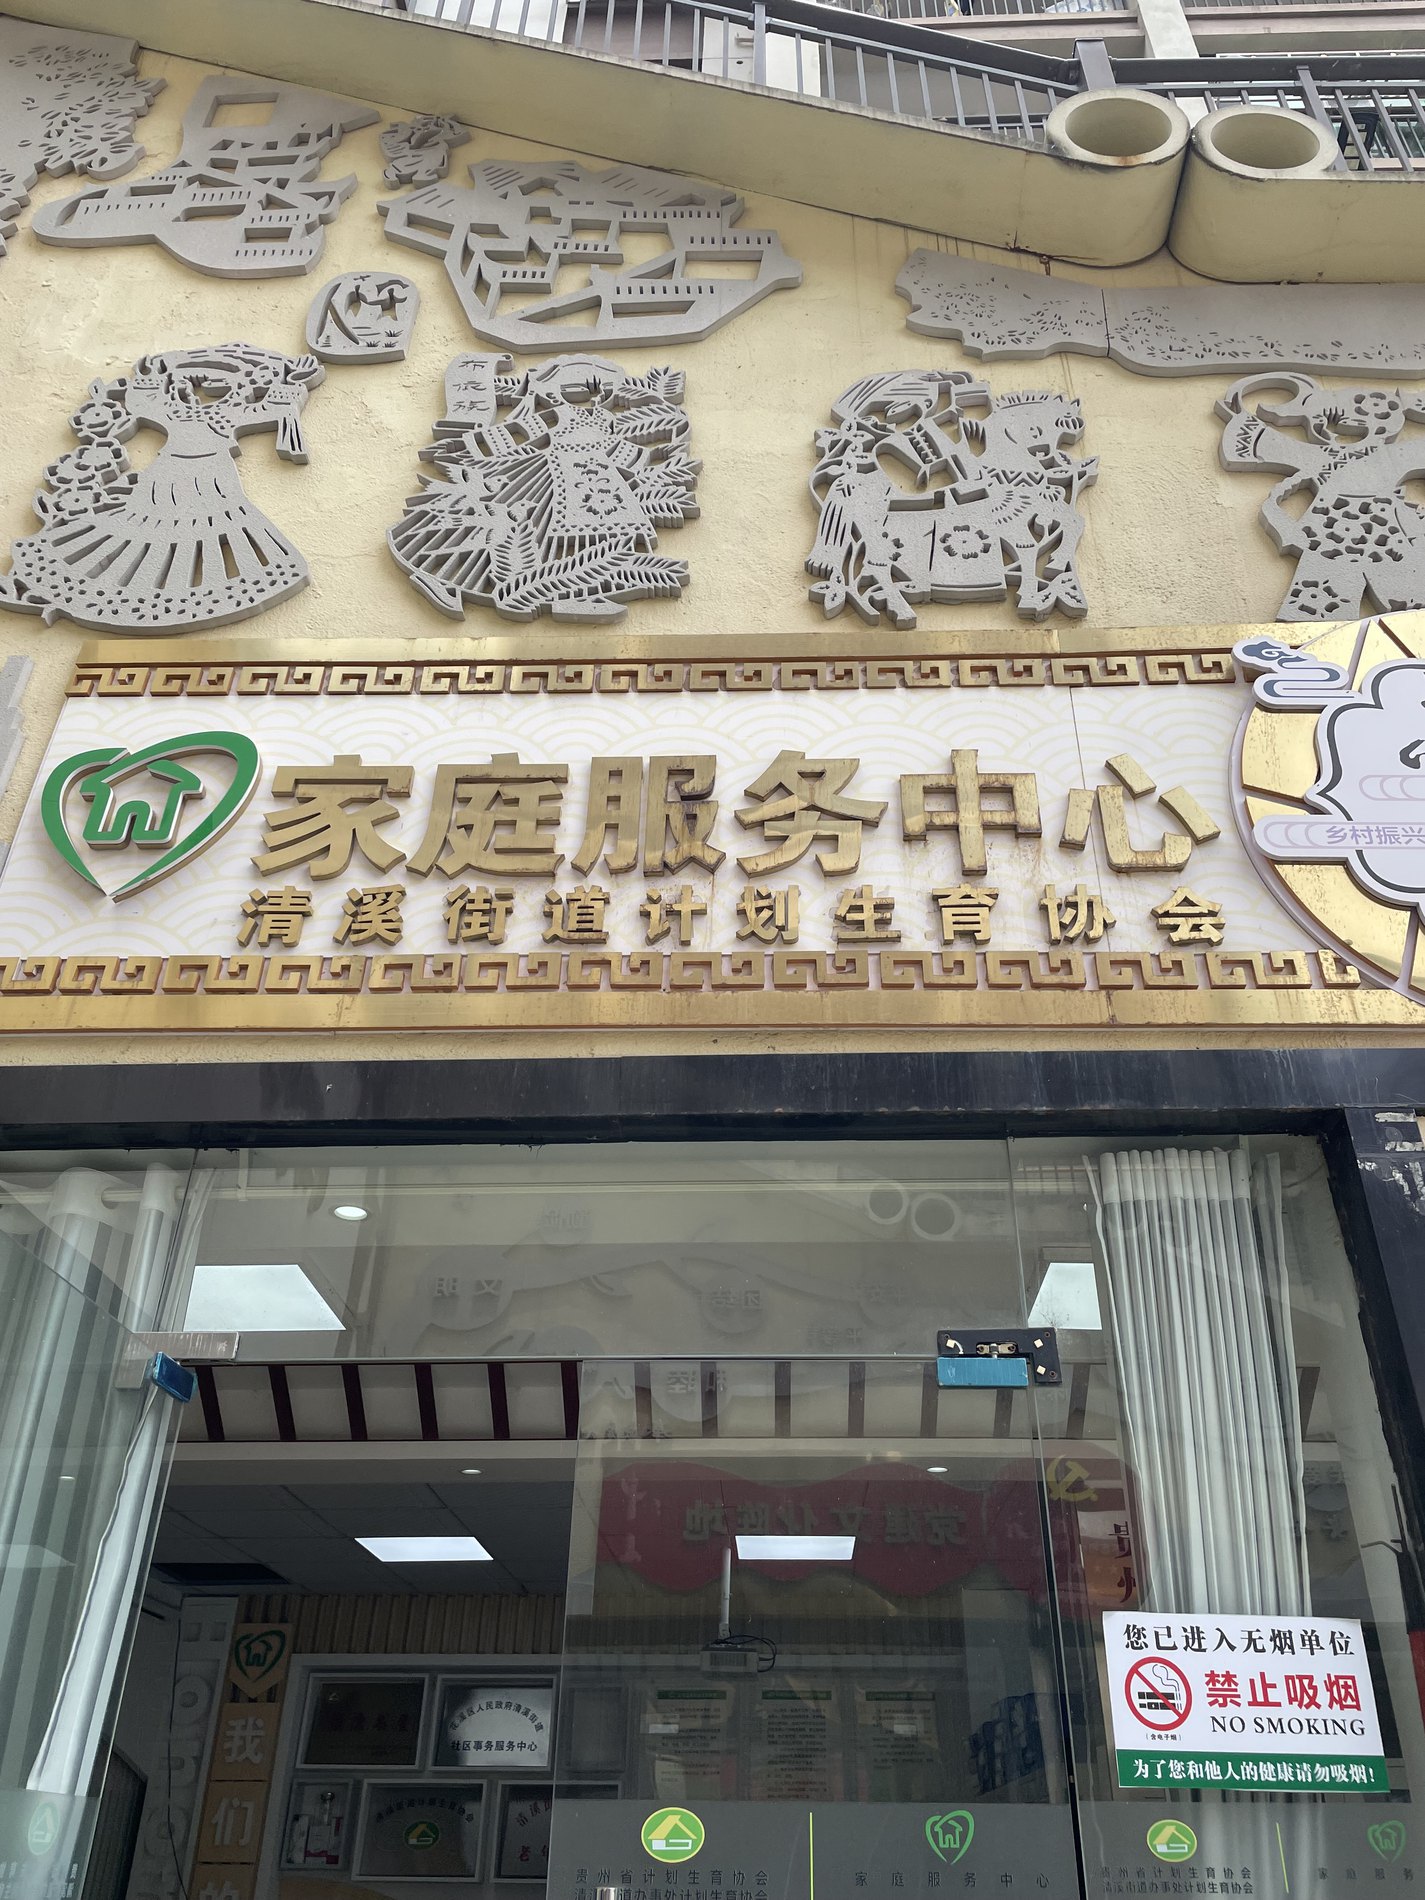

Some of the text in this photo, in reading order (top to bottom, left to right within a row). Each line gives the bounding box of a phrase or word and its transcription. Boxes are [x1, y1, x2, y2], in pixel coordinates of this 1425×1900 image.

[250, 749, 1220, 881] 家庭服务中心
[1325, 825, 1425, 845] 乡村振兴
[236, 884, 1226, 947] 清溪街道计划生育协会
[1123, 1624, 1355, 1656] 您已进入无烟单位
[1204, 1670, 1362, 1711] 禁止吸烟
[1210, 1716, 1365, 1736] NO SMOKING
[450, 1740, 538, 1752] 社区事务服务中心
[575, 1868, 768, 1886] 贵州省计划生育协会
[855, 1871, 1050, 1889] 家庭服务中心
